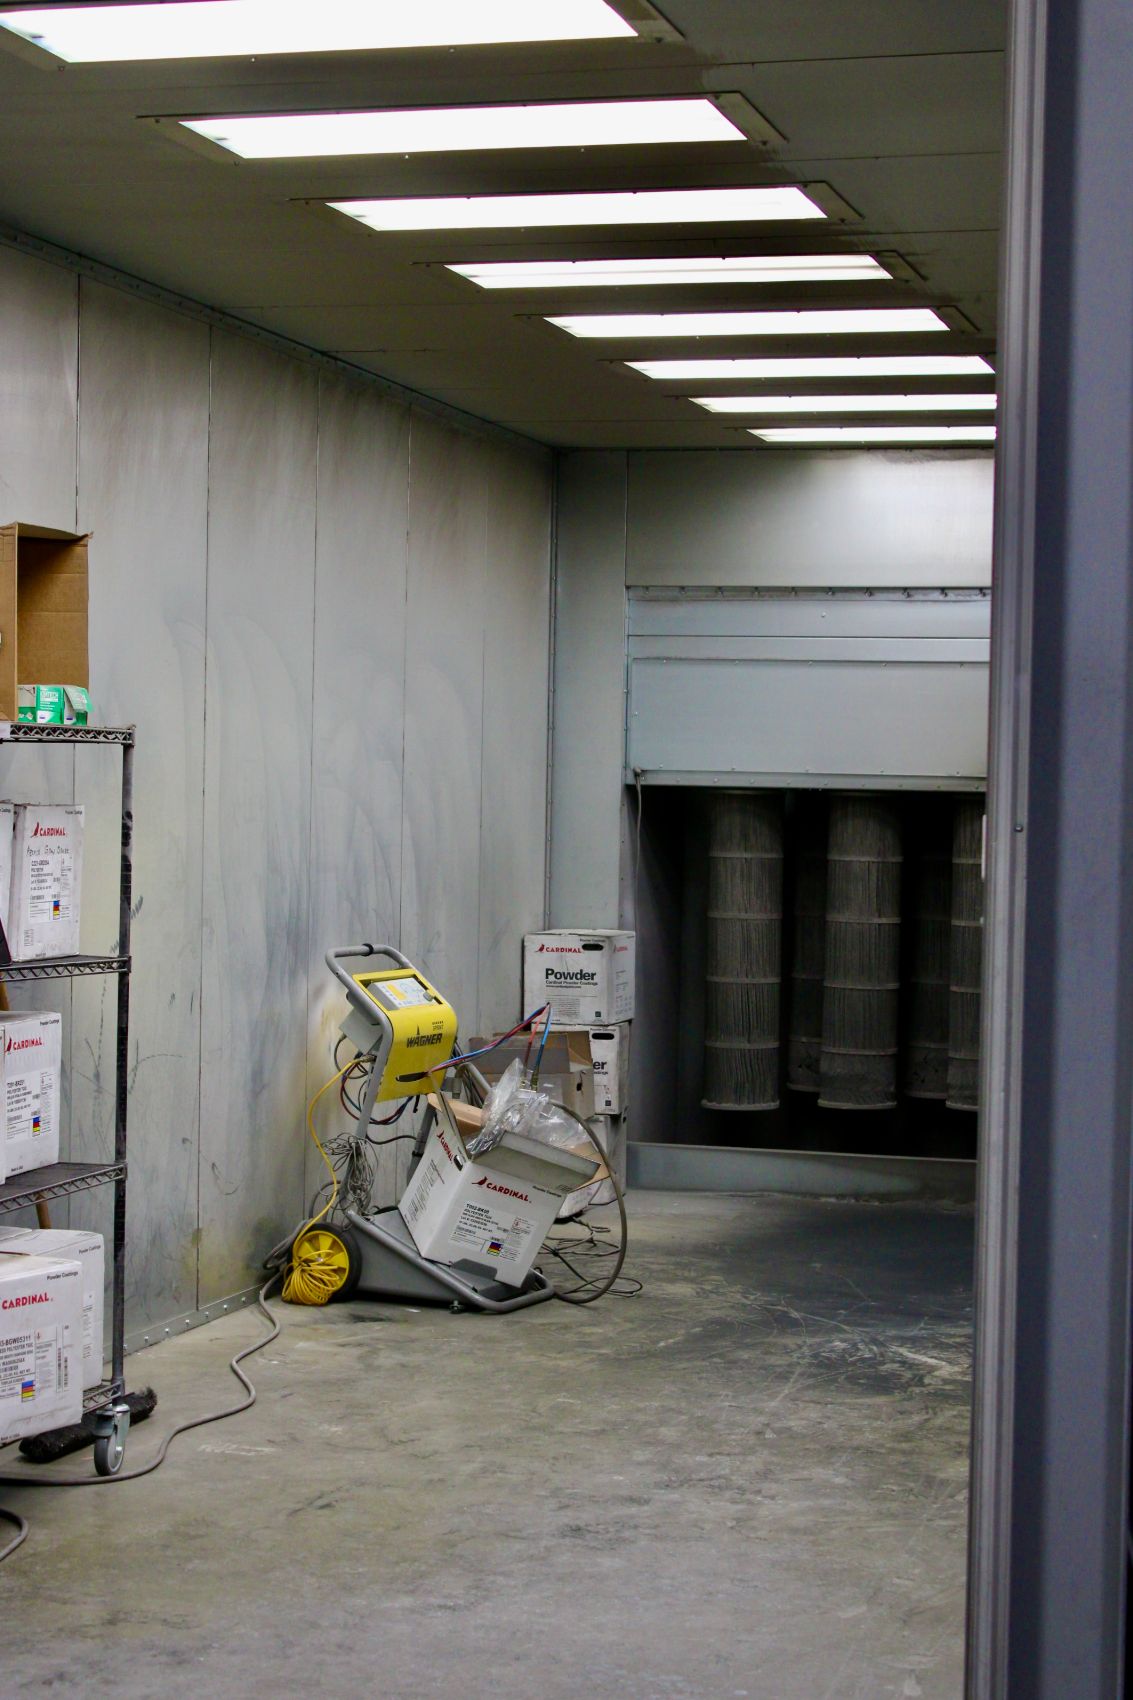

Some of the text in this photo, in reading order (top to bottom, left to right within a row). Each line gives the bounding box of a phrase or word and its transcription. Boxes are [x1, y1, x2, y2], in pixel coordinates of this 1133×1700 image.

[40, 827, 66, 837] CARDINAL
[546, 968, 596, 980] Powder
[13, 1037, 42, 1050] CARDINAL
[406, 1033, 443, 1048] WAGNER
[486, 1182, 528, 1201] CARDINAL
[2, 1292, 49, 1310] CARDINAL
